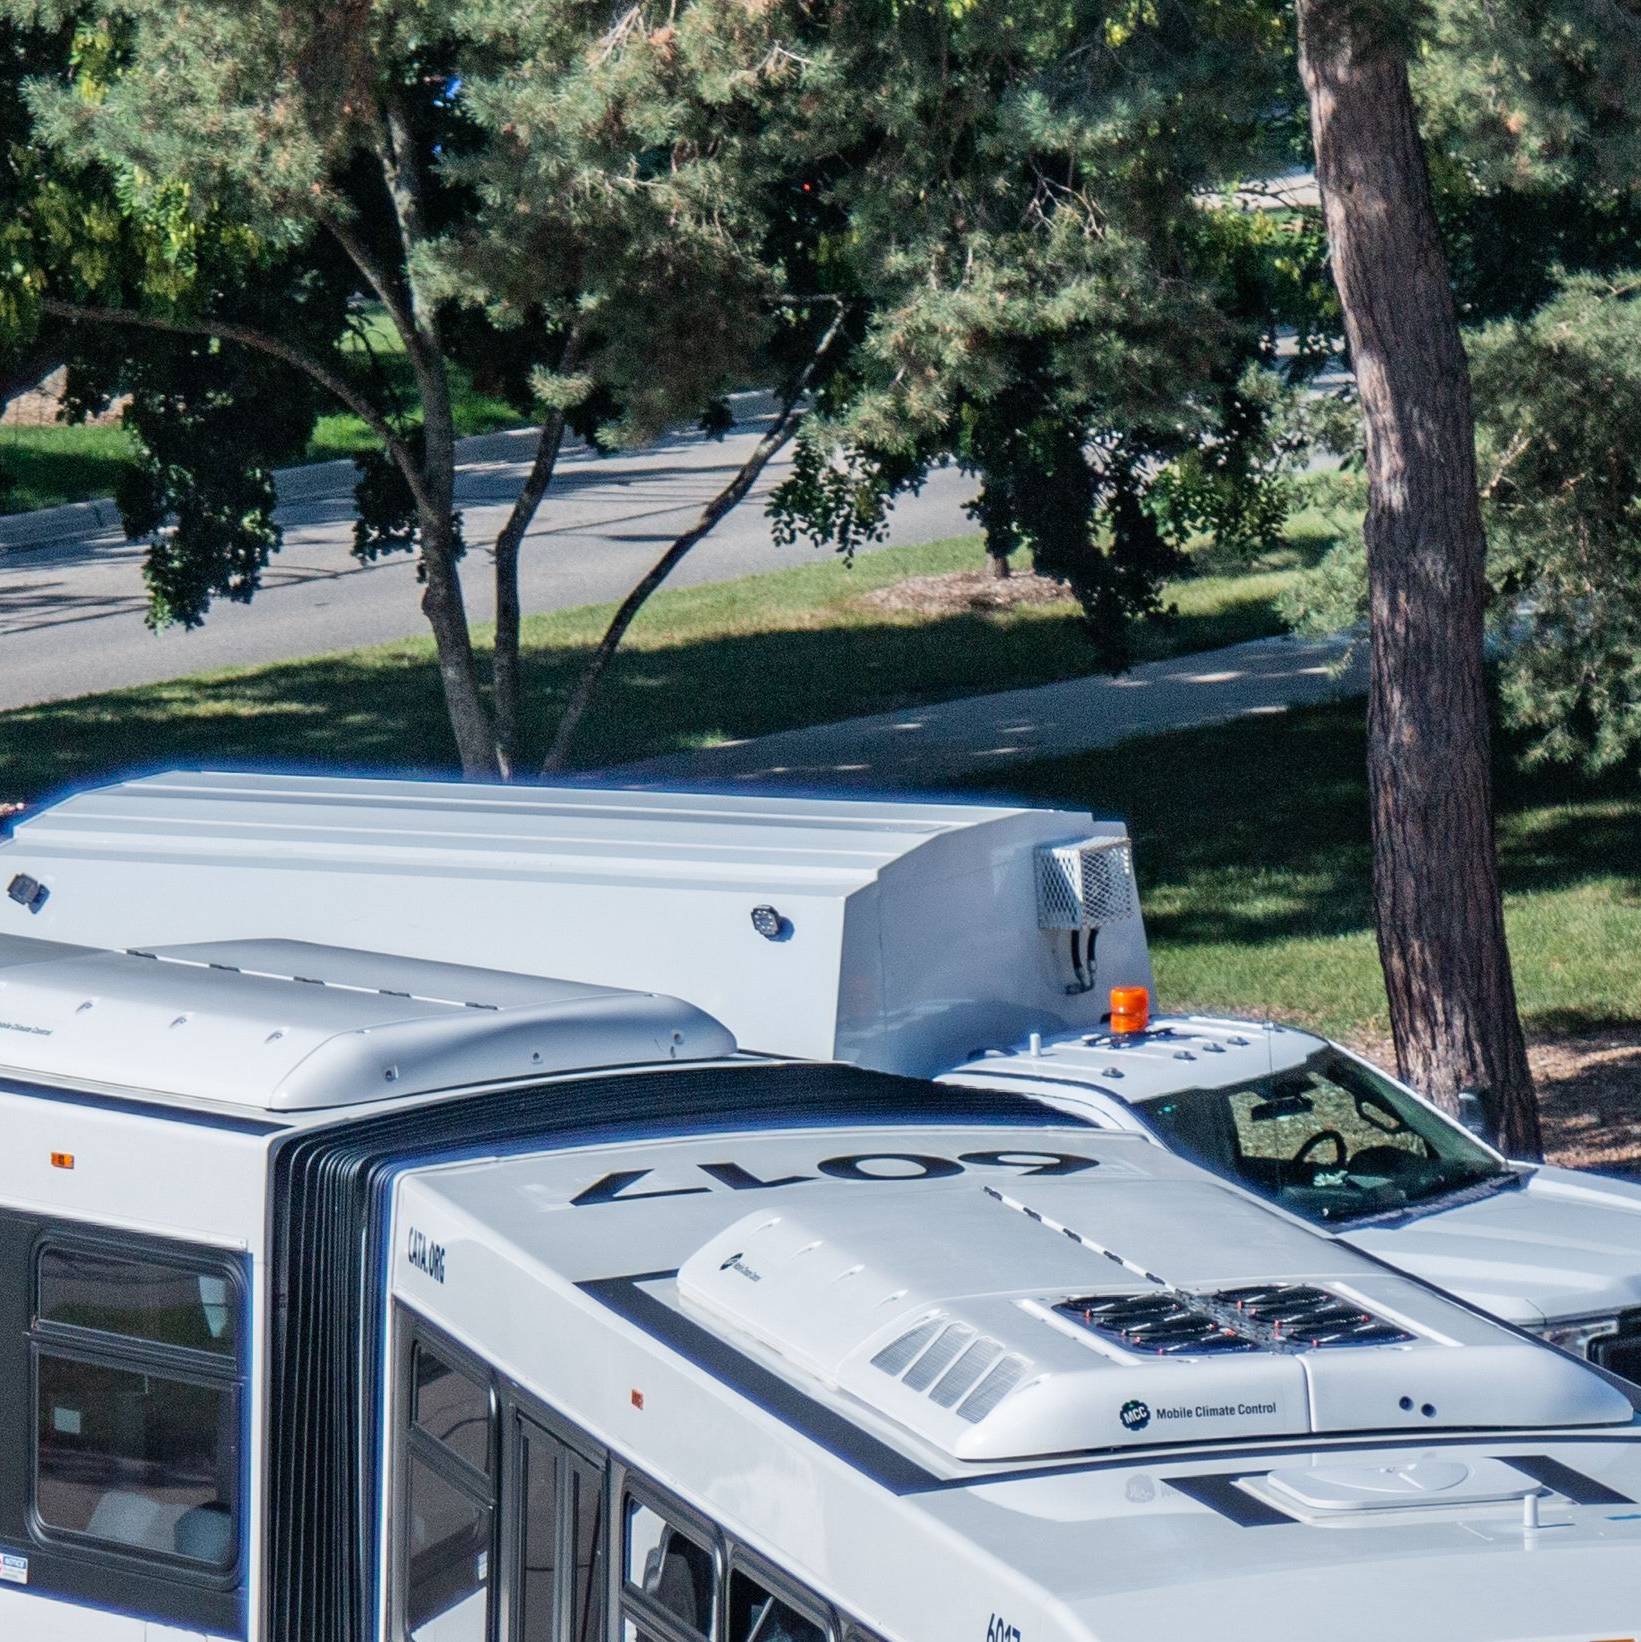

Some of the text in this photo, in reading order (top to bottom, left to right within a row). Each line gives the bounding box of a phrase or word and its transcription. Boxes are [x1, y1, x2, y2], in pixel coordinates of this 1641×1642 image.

[570, 1150, 1100, 1207] 6017
[408, 1226, 445, 1285] CATA.ORG
[1123, 1402, 1276, 1425] MCC Mobile Climate Control
